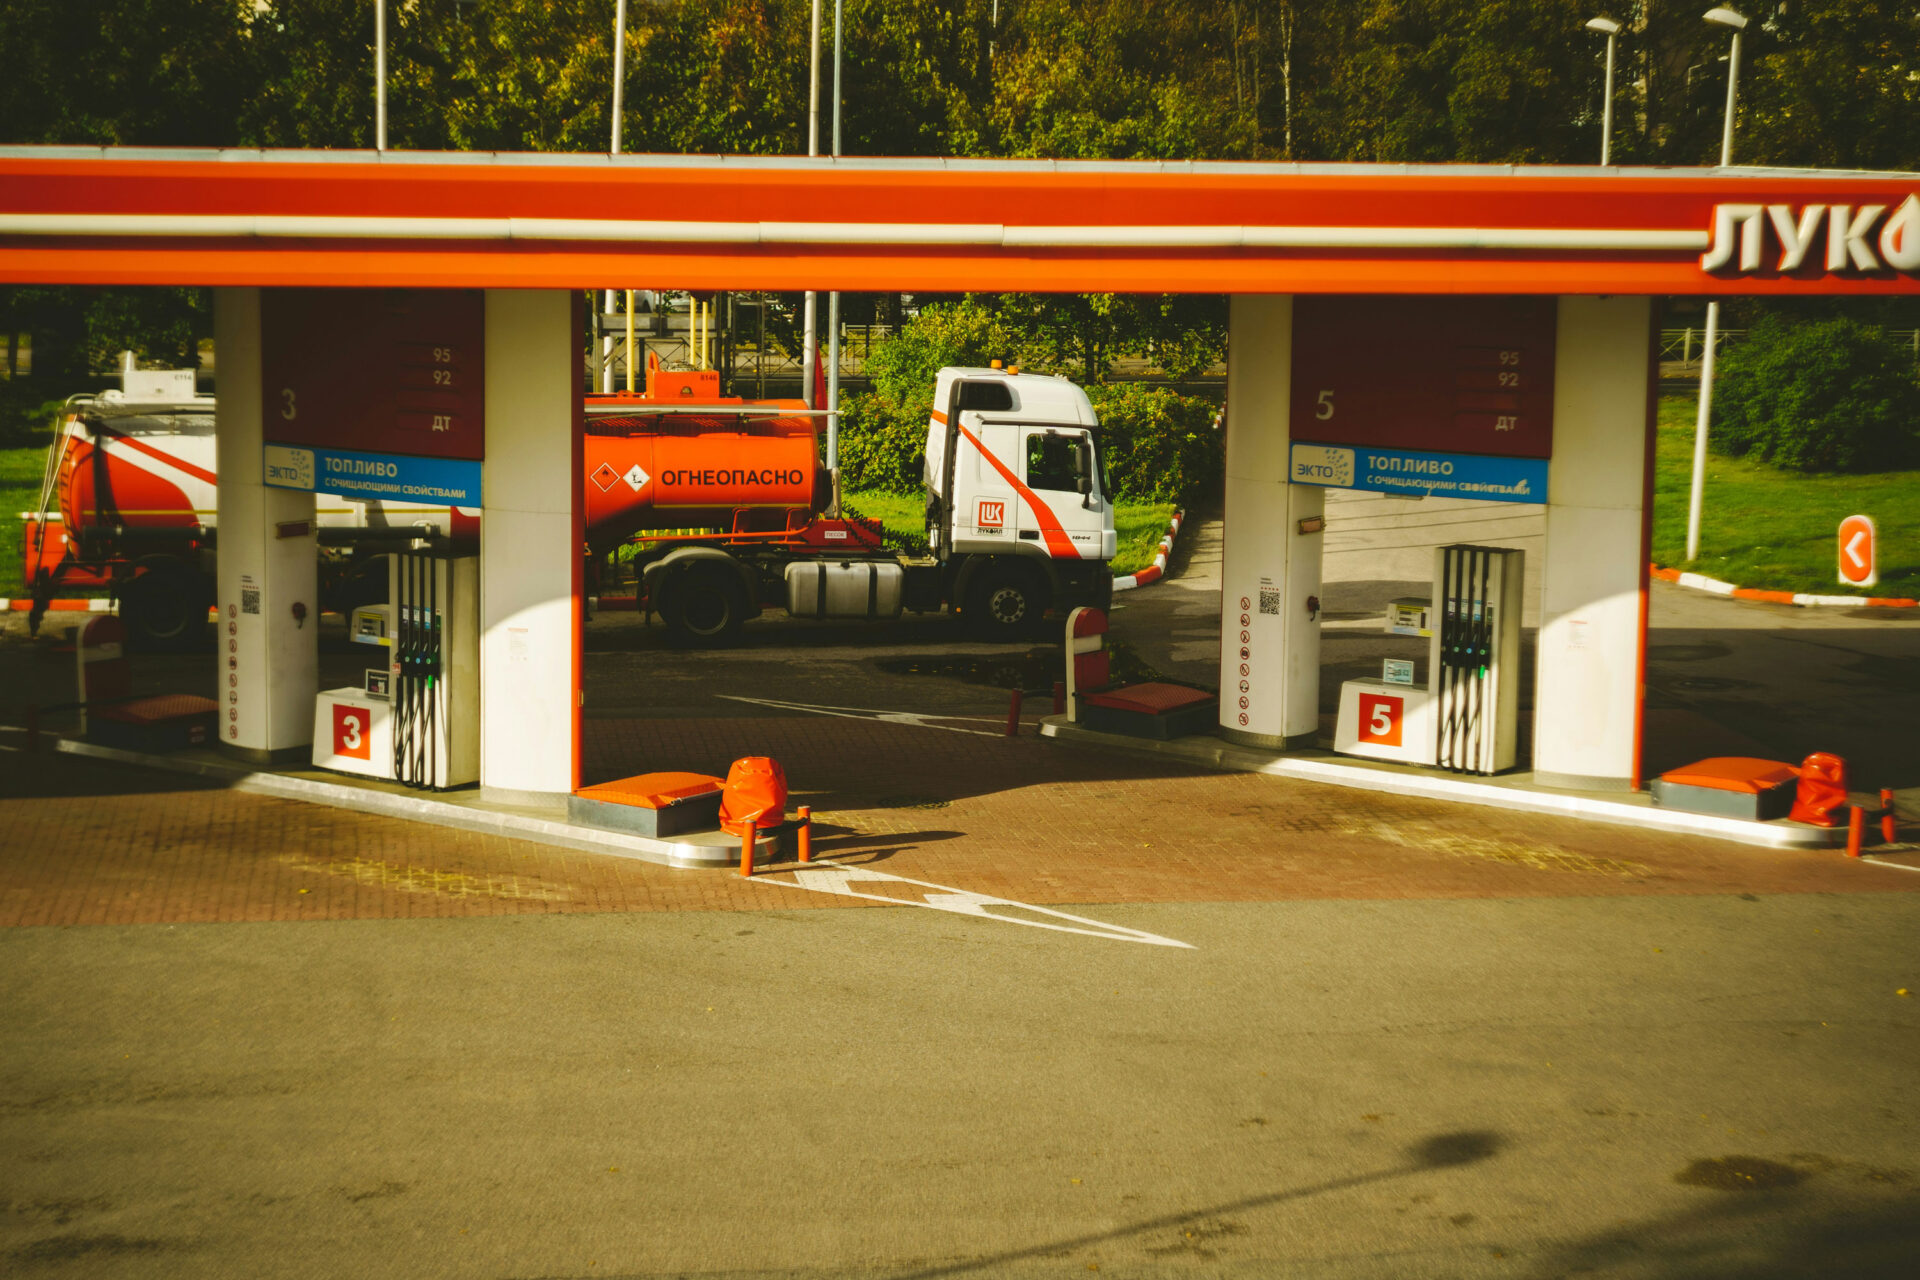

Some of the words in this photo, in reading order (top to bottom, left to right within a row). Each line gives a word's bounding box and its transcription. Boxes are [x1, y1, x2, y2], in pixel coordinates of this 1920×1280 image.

[433, 348, 451, 363] 95
[1500, 351, 1519, 365] 95
[433, 370, 451, 385] 92
[1498, 372, 1519, 386] 92
[281, 388, 296, 420] 3
[1315, 390, 1335, 420] 5
[432, 415, 451, 432] ДТ
[1495, 416, 1518, 431] ДТ
[268, 465, 298, 480] ЭКТО
[325, 457, 398, 478] ТОПЛИВО
[1297, 463, 1333, 478] ЭКТО
[1368, 456, 1454, 475] ТОПЛИВО
[661, 470, 804, 486] ОГНЕОПАСНО
[1375, 475, 1457, 491] ОЧИЩАЮЩИМИ
[332, 478, 400, 493] ОЧИЩАЮЩИМИ
[402, 485, 466, 499] СВОЙСТВАМИ
[1370, 703, 1392, 736] 5
[343, 715, 361, 750] 3
